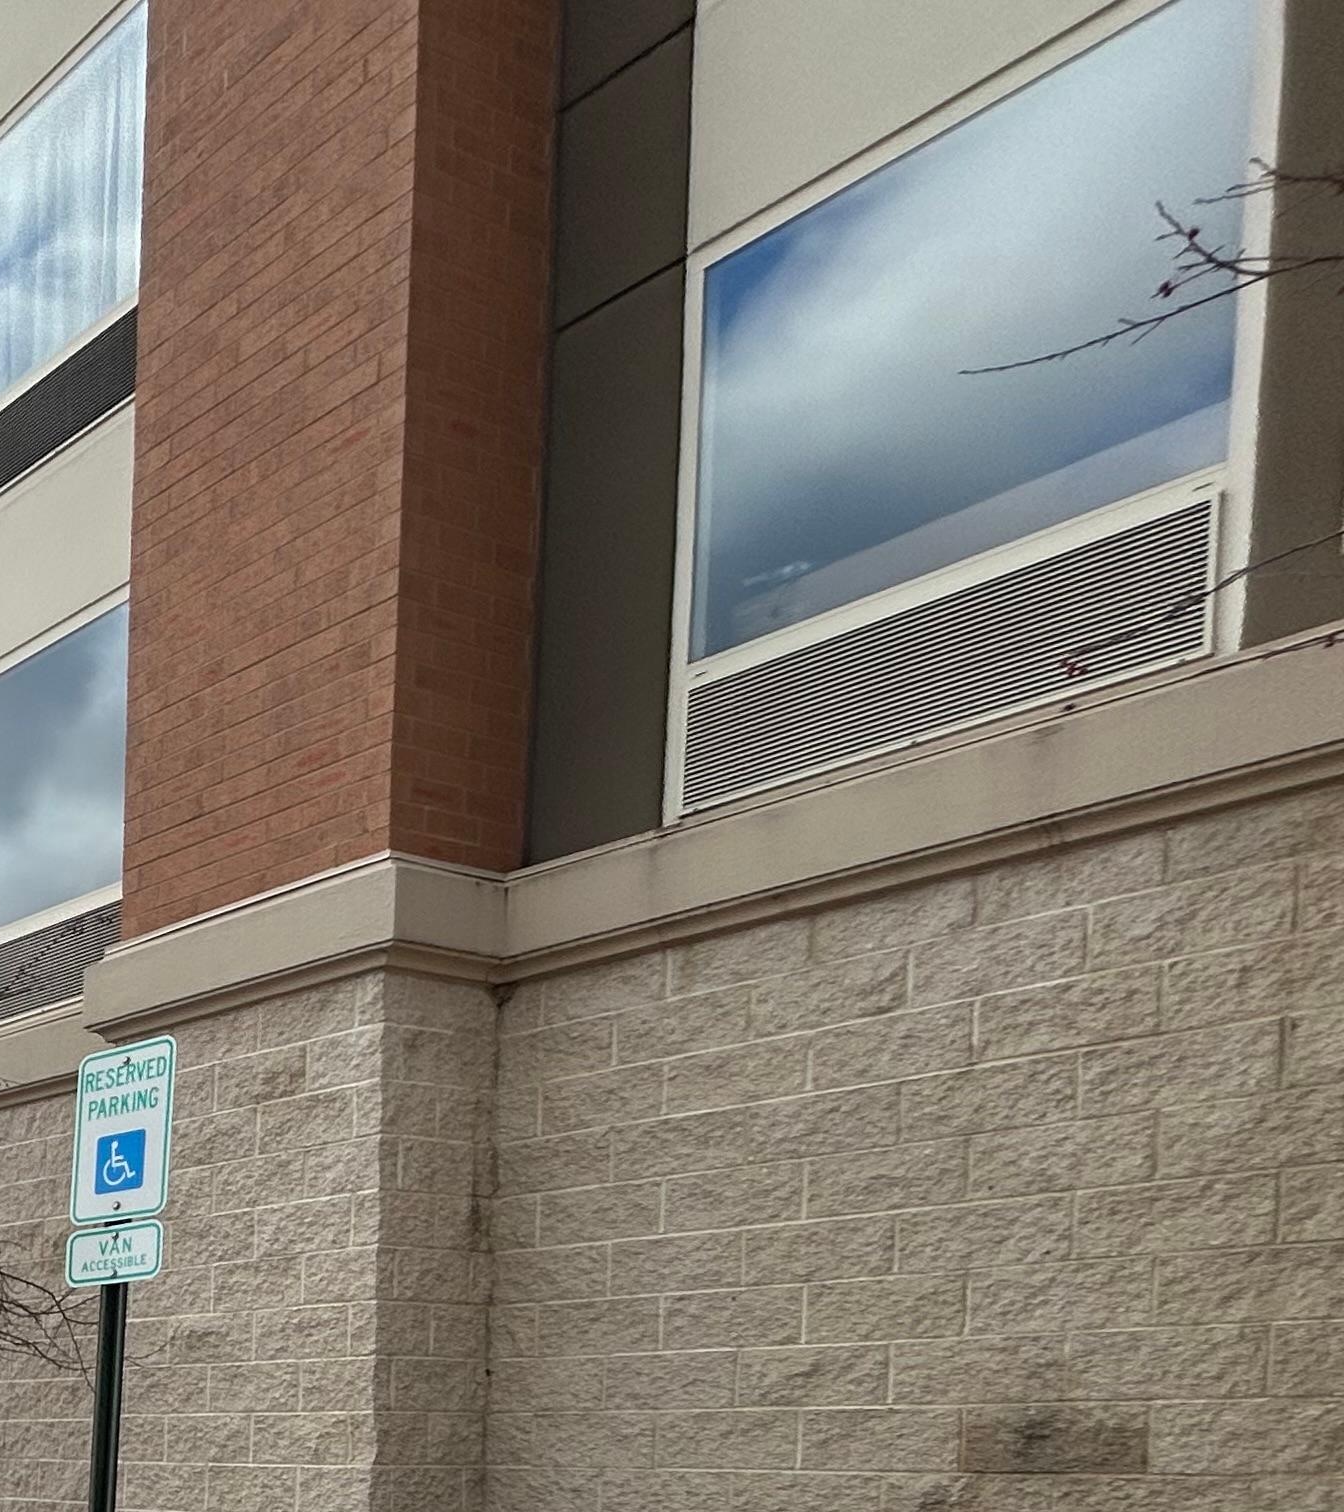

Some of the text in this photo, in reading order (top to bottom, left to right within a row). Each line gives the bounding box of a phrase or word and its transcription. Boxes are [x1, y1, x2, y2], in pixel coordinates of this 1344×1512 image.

[85, 1056, 167, 1093] RESERVED
[88, 1086, 160, 1121] PARKING
[99, 1237, 132, 1256] VAN
[81, 1254, 147, 1273] ACCESSIBLE
